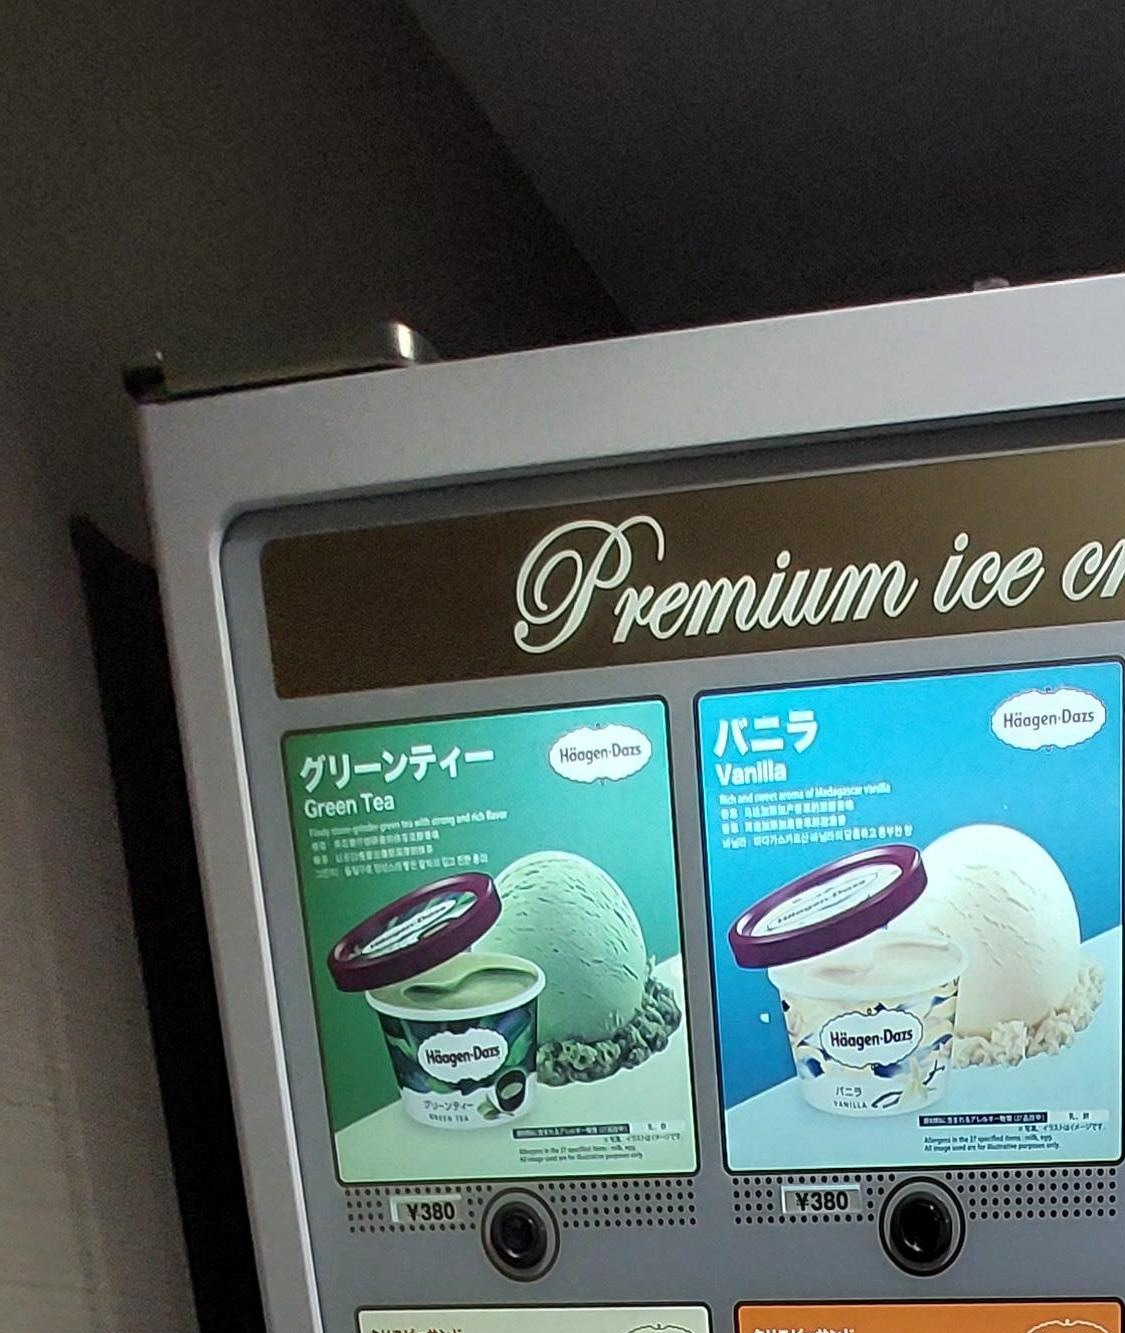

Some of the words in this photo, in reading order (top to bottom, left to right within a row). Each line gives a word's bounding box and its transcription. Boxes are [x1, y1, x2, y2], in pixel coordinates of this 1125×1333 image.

[513, 515, 919, 654] Premium
[933, 532, 1044, 614] ice
[1003, 709, 1094, 730] Häagen-Dazs
[713, 709, 817, 758] バニラ
[559, 743, 642, 765] Häagen-Dazs
[300, 745, 494, 793] グリーンティー
[716, 760, 787, 786] Vanilla
[305, 798, 357, 818] Green
[360, 793, 395, 813] Tea
[830, 1029, 913, 1050] Häagen-Dazs
[426, 1045, 500, 1068] Häagen-Dazs
[836, 1086, 863, 1098] バニラ
[833, 1100, 868, 1109] VANILLA
[406, 1202, 455, 1221] ¥380
[795, 1191, 849, 1211] ¥380
